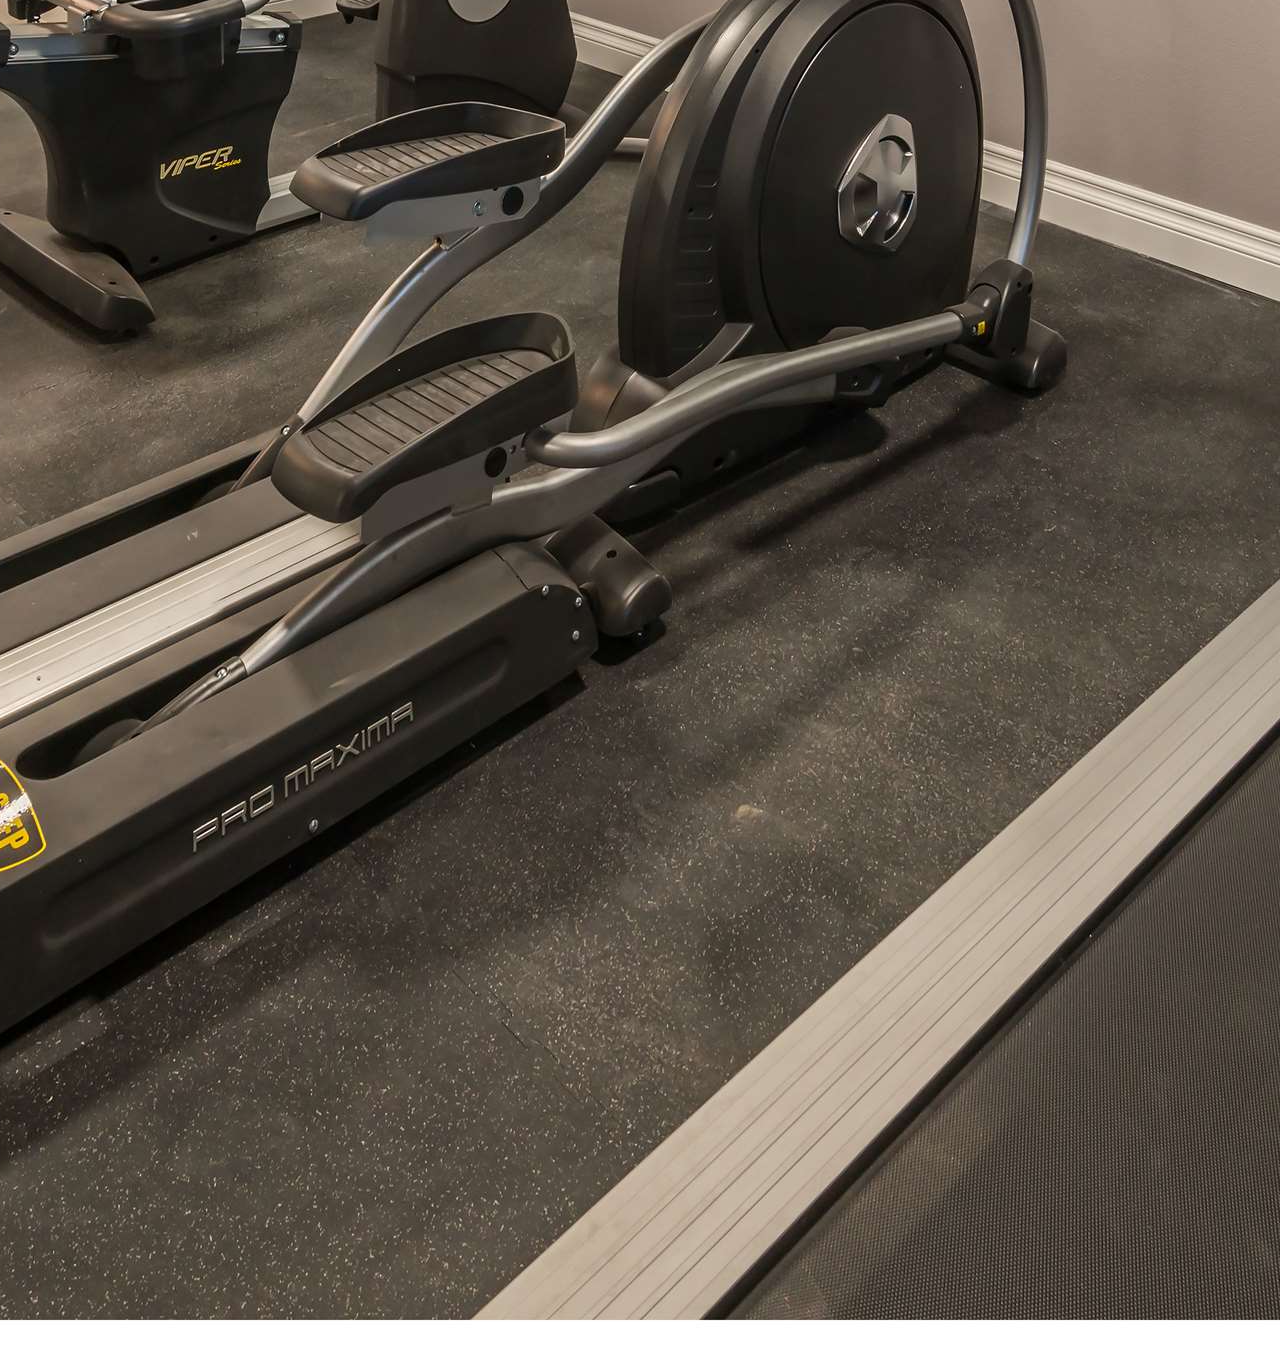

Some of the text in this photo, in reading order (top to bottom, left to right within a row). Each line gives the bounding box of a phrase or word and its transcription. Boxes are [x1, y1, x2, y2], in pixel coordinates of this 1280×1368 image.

[160, 145, 233, 180] VIPER
[193, 701, 414, 853] PRO MAXIMA
